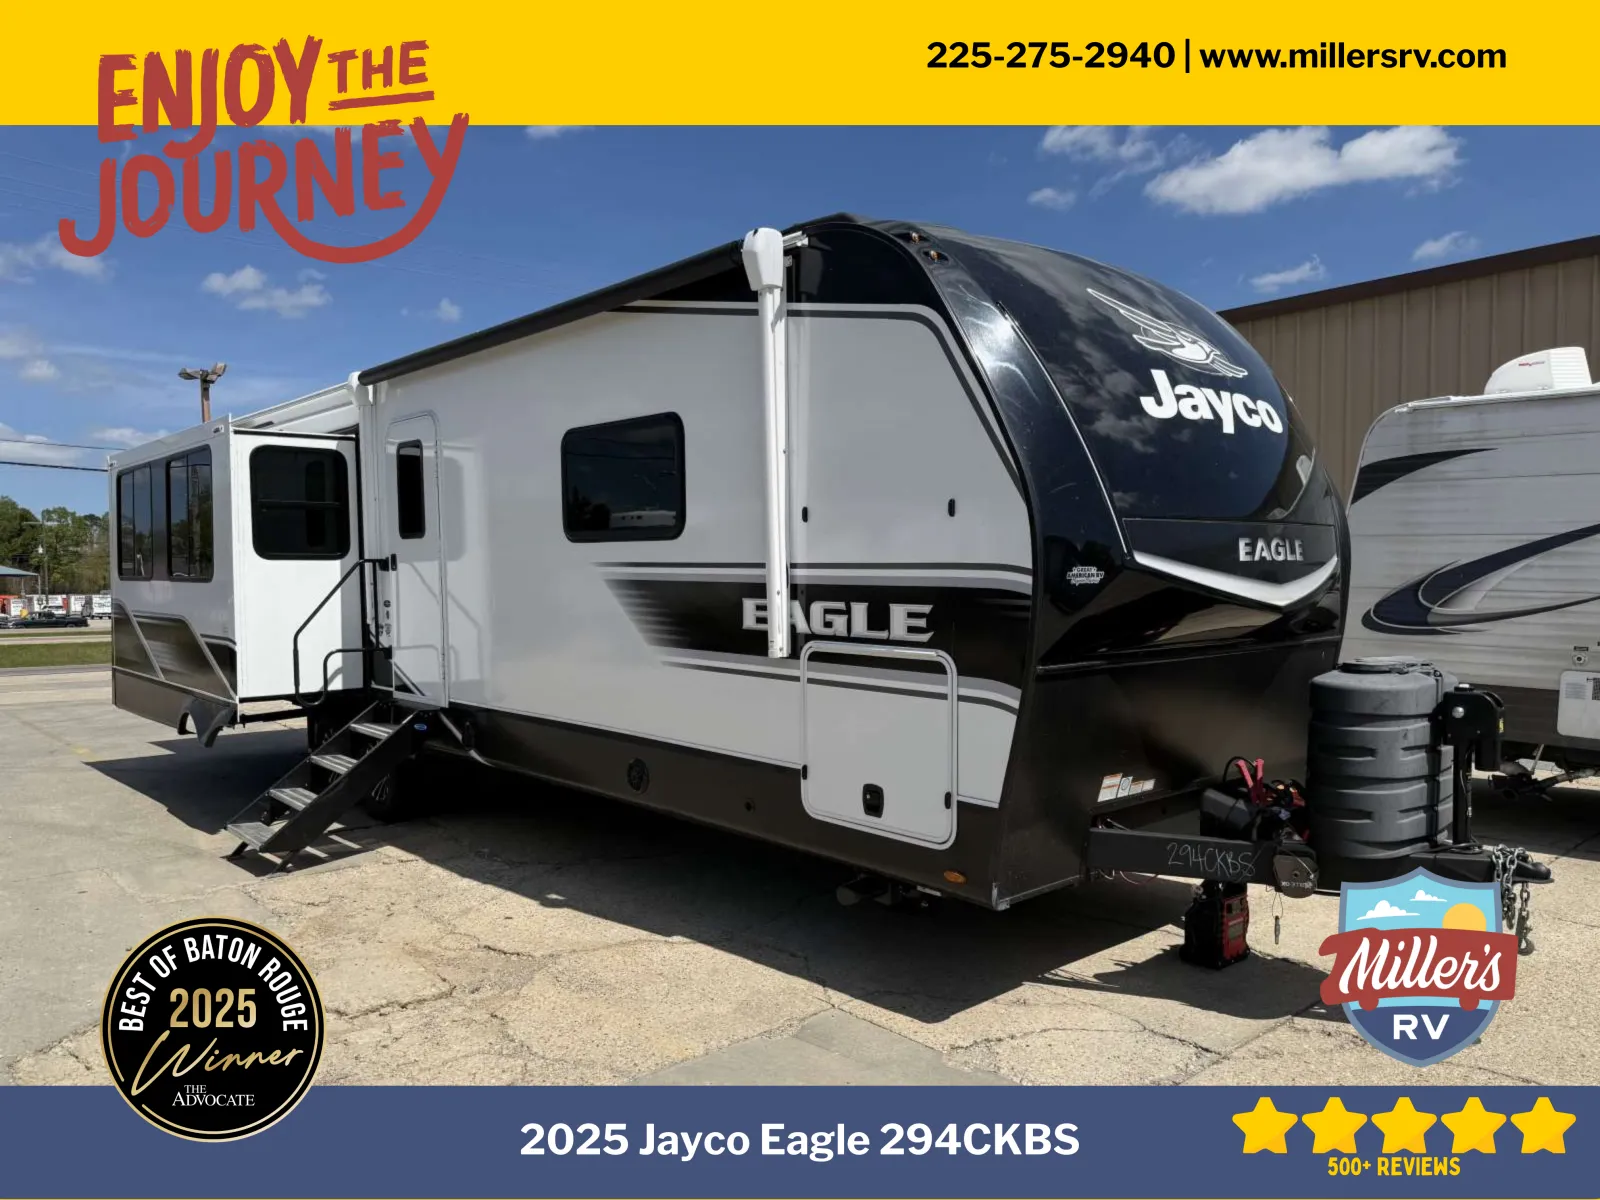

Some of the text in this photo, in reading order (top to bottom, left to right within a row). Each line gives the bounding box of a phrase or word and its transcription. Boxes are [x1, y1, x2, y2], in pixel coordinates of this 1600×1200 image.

[1139, 369, 1283, 434] Jayco
[1238, 537, 1304, 562] EAGLE
[742, 598, 935, 642] EAGLE
[1166, 842, 1256, 879] 294CKBS
